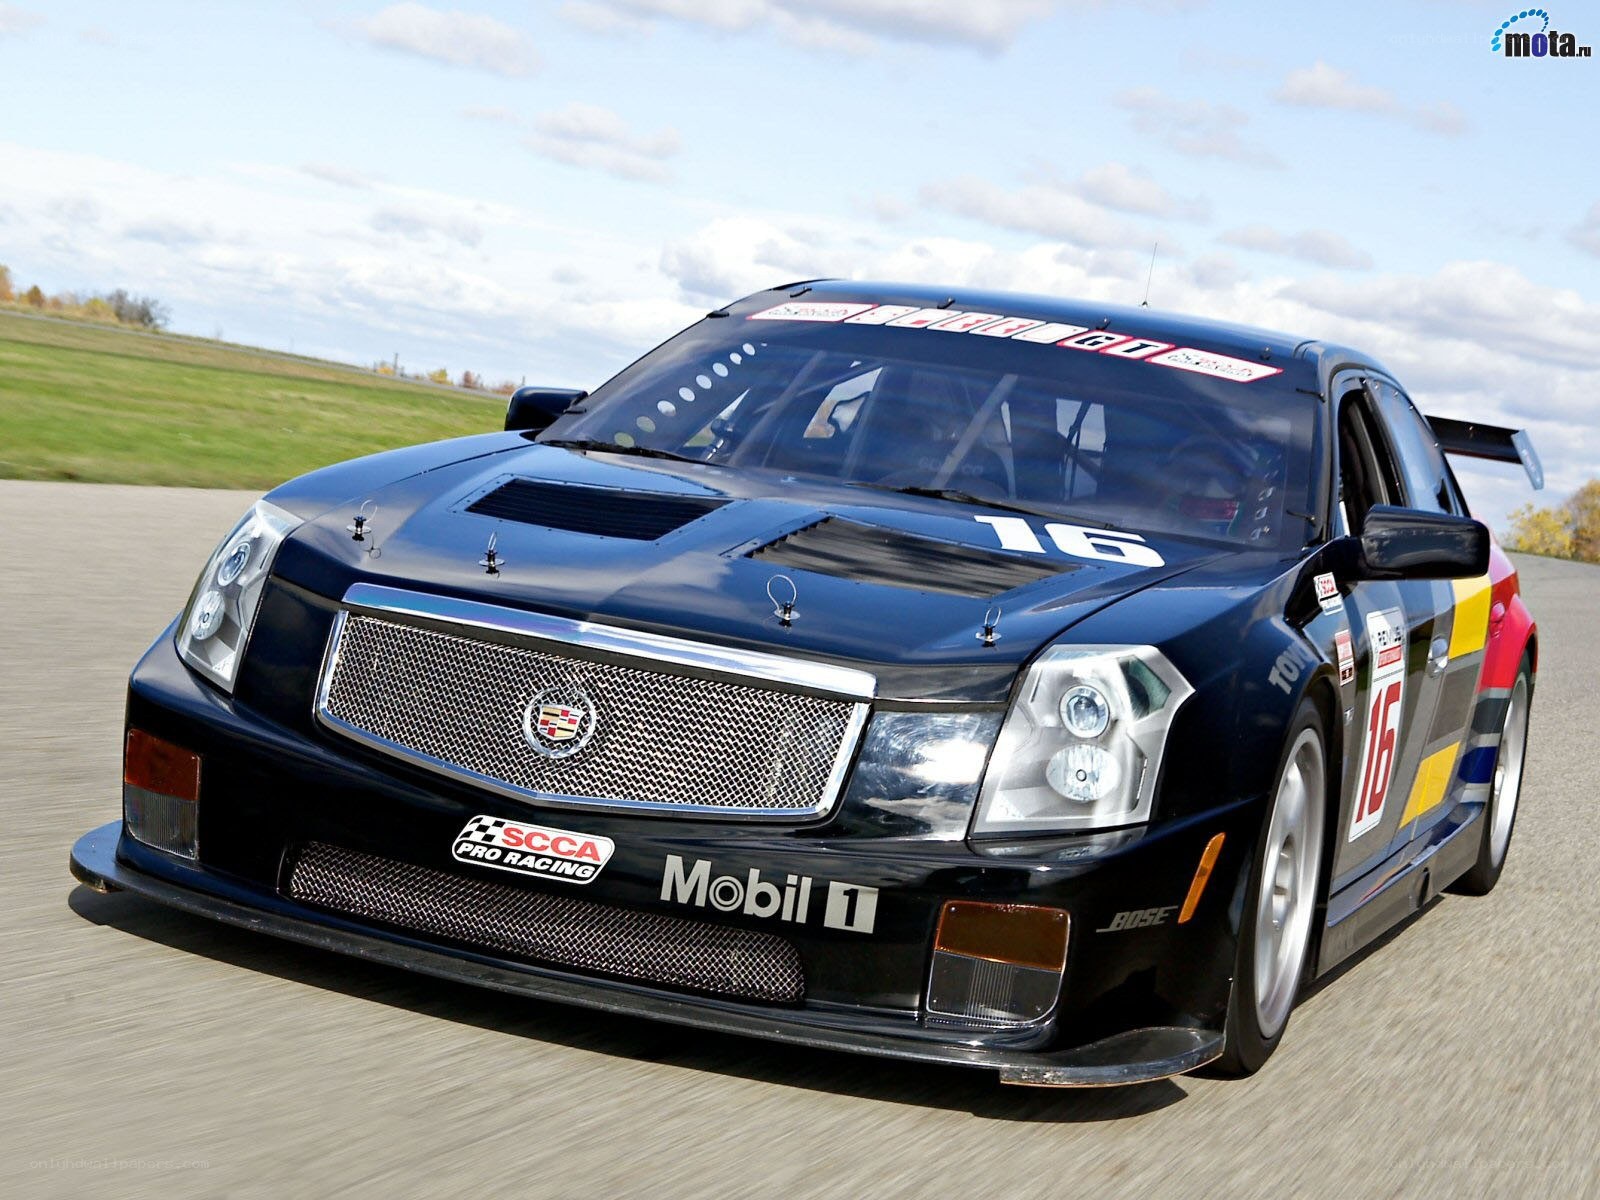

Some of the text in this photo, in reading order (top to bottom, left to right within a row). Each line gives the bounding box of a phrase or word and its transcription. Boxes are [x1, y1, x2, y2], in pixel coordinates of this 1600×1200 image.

[1072, 333, 1160, 354] GT
[973, 515, 1166, 568] 16
[1355, 681, 1402, 823] 16
[456, 843, 596, 878] PRO RACING
[501, 827, 601, 862] SCCA
[660, 854, 813, 924] Mobil
[1096, 905, 1178, 933] BOSE
